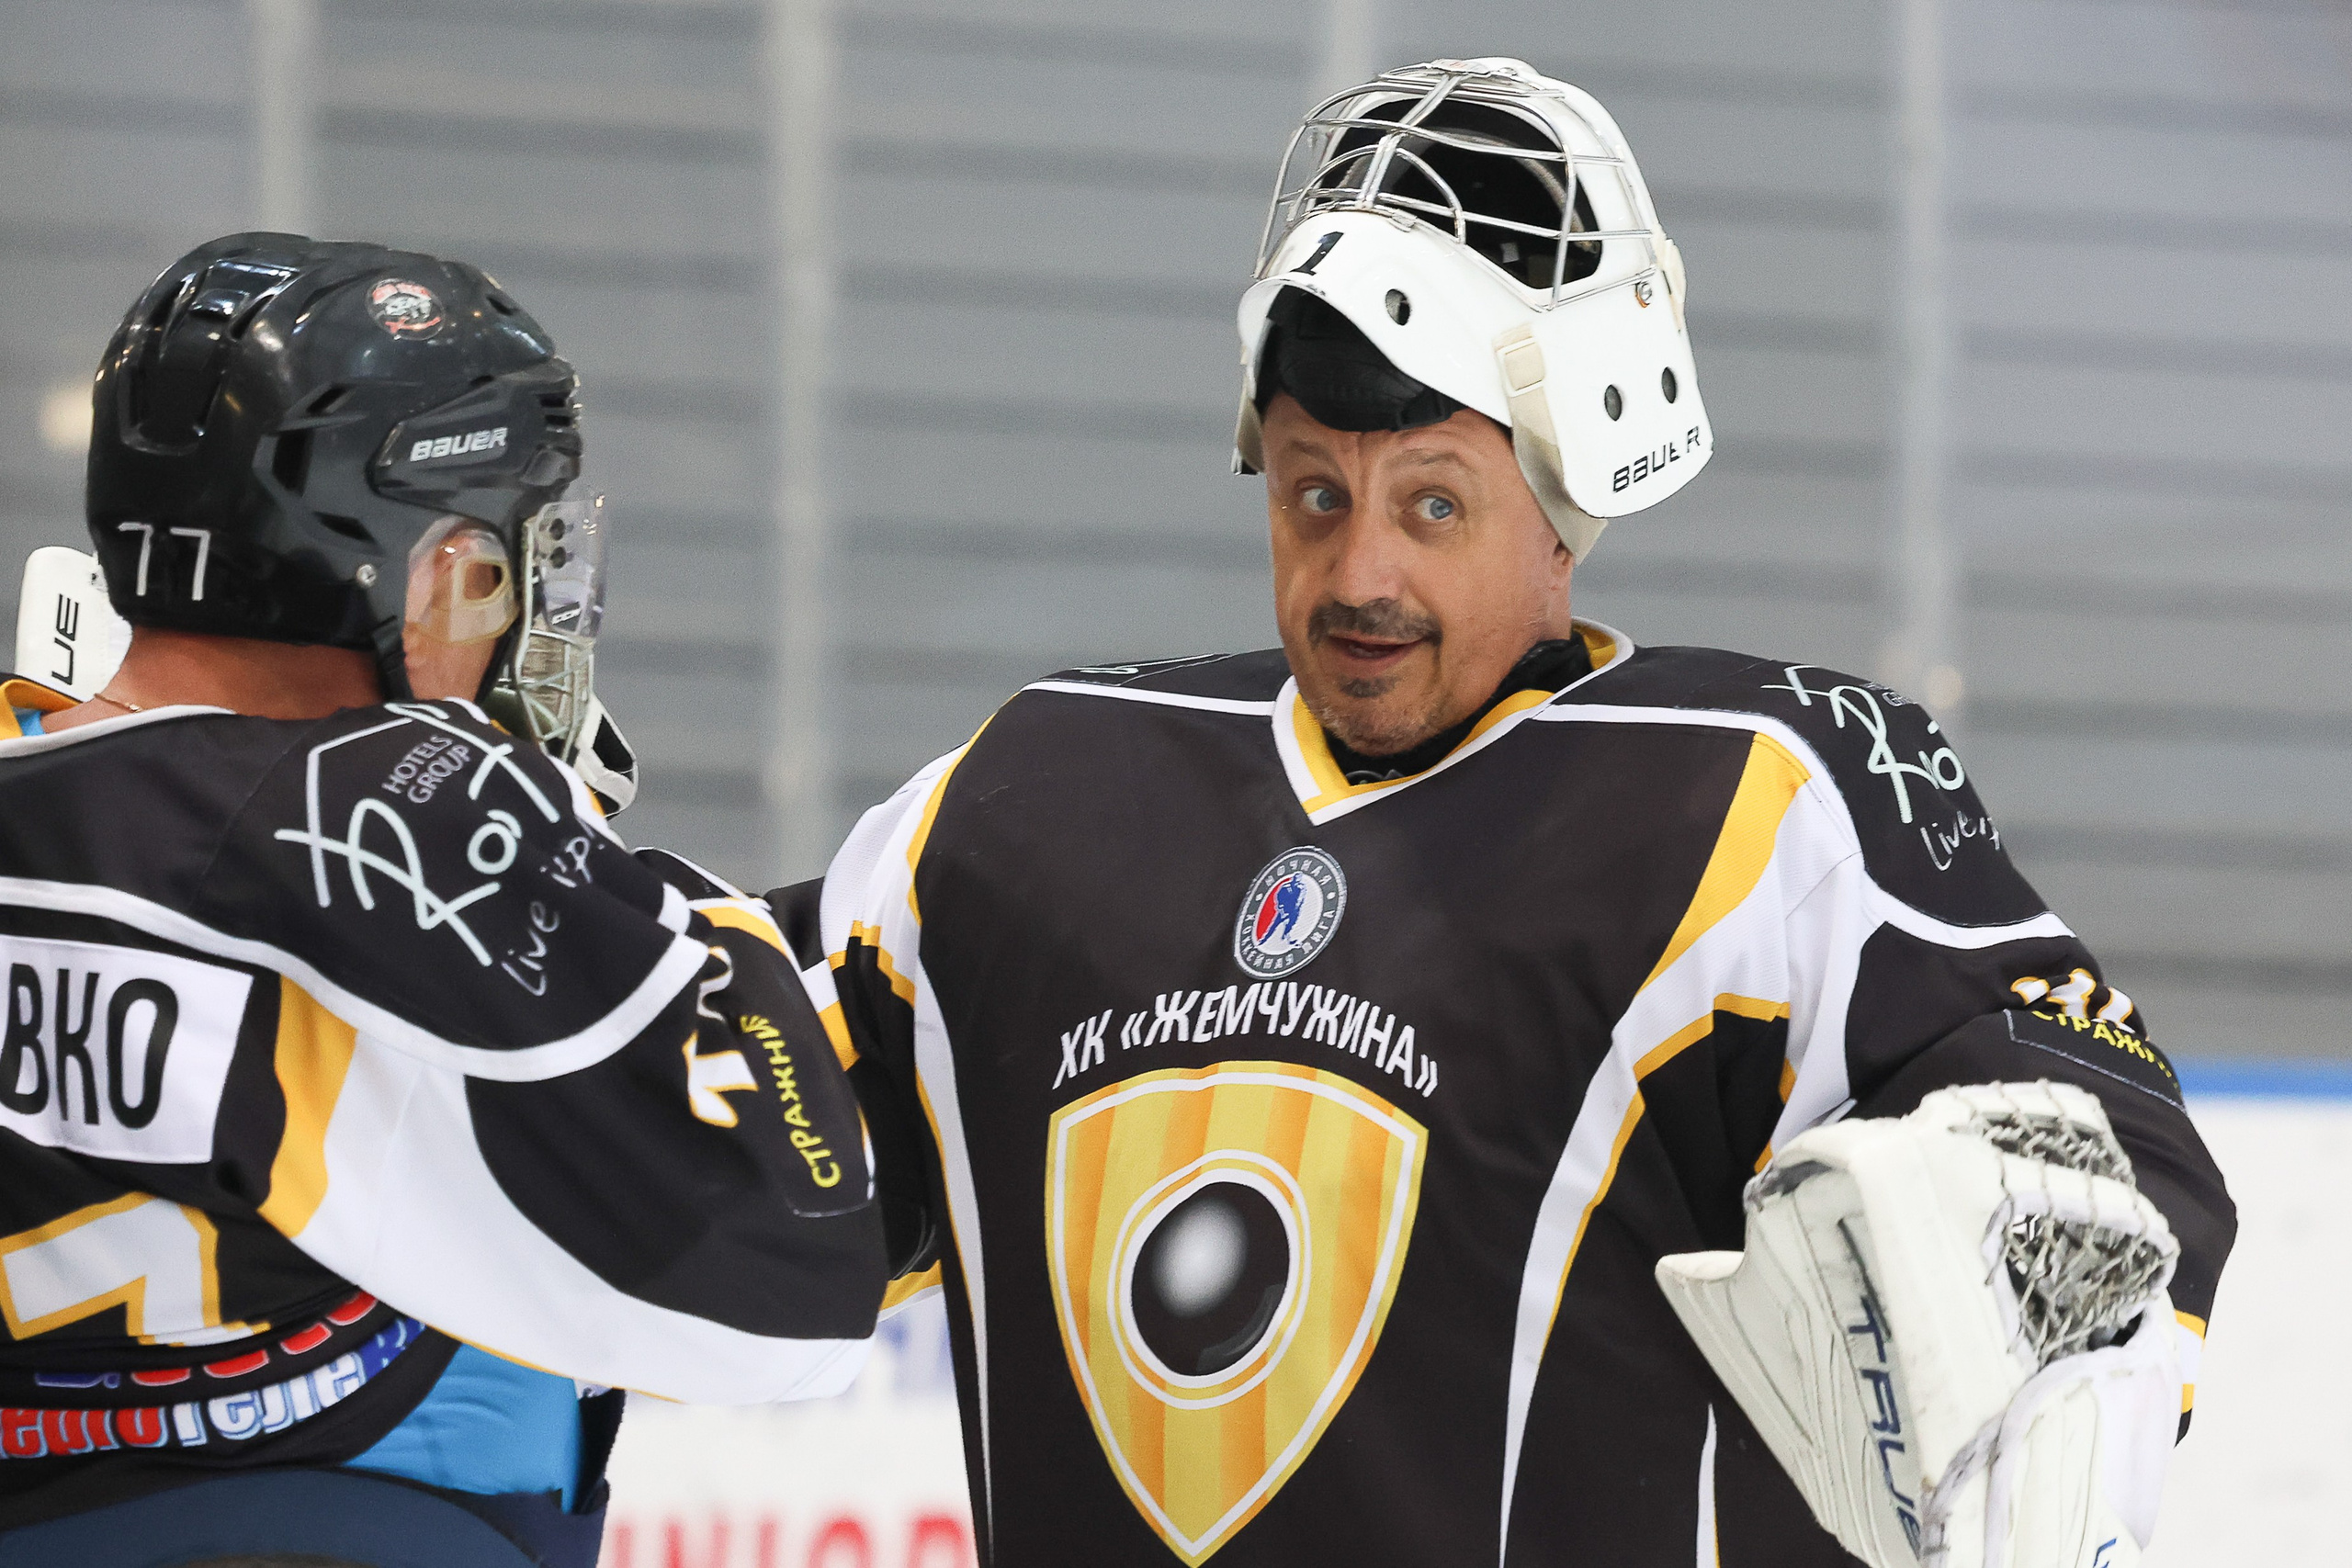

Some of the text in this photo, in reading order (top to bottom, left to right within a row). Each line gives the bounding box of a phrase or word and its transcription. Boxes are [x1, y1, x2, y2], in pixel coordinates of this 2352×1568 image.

[1289, 231, 1344, 276] 1
[409, 426, 509, 462] BAUER
[118, 521, 211, 602] 77
[380, 734, 455, 795] HOTELS
[406, 744, 471, 804] GROUP
[501, 900, 560, 989] Live
[1051, 981, 1440, 1099] ХК «ЖЕМЧУЖИНА»
